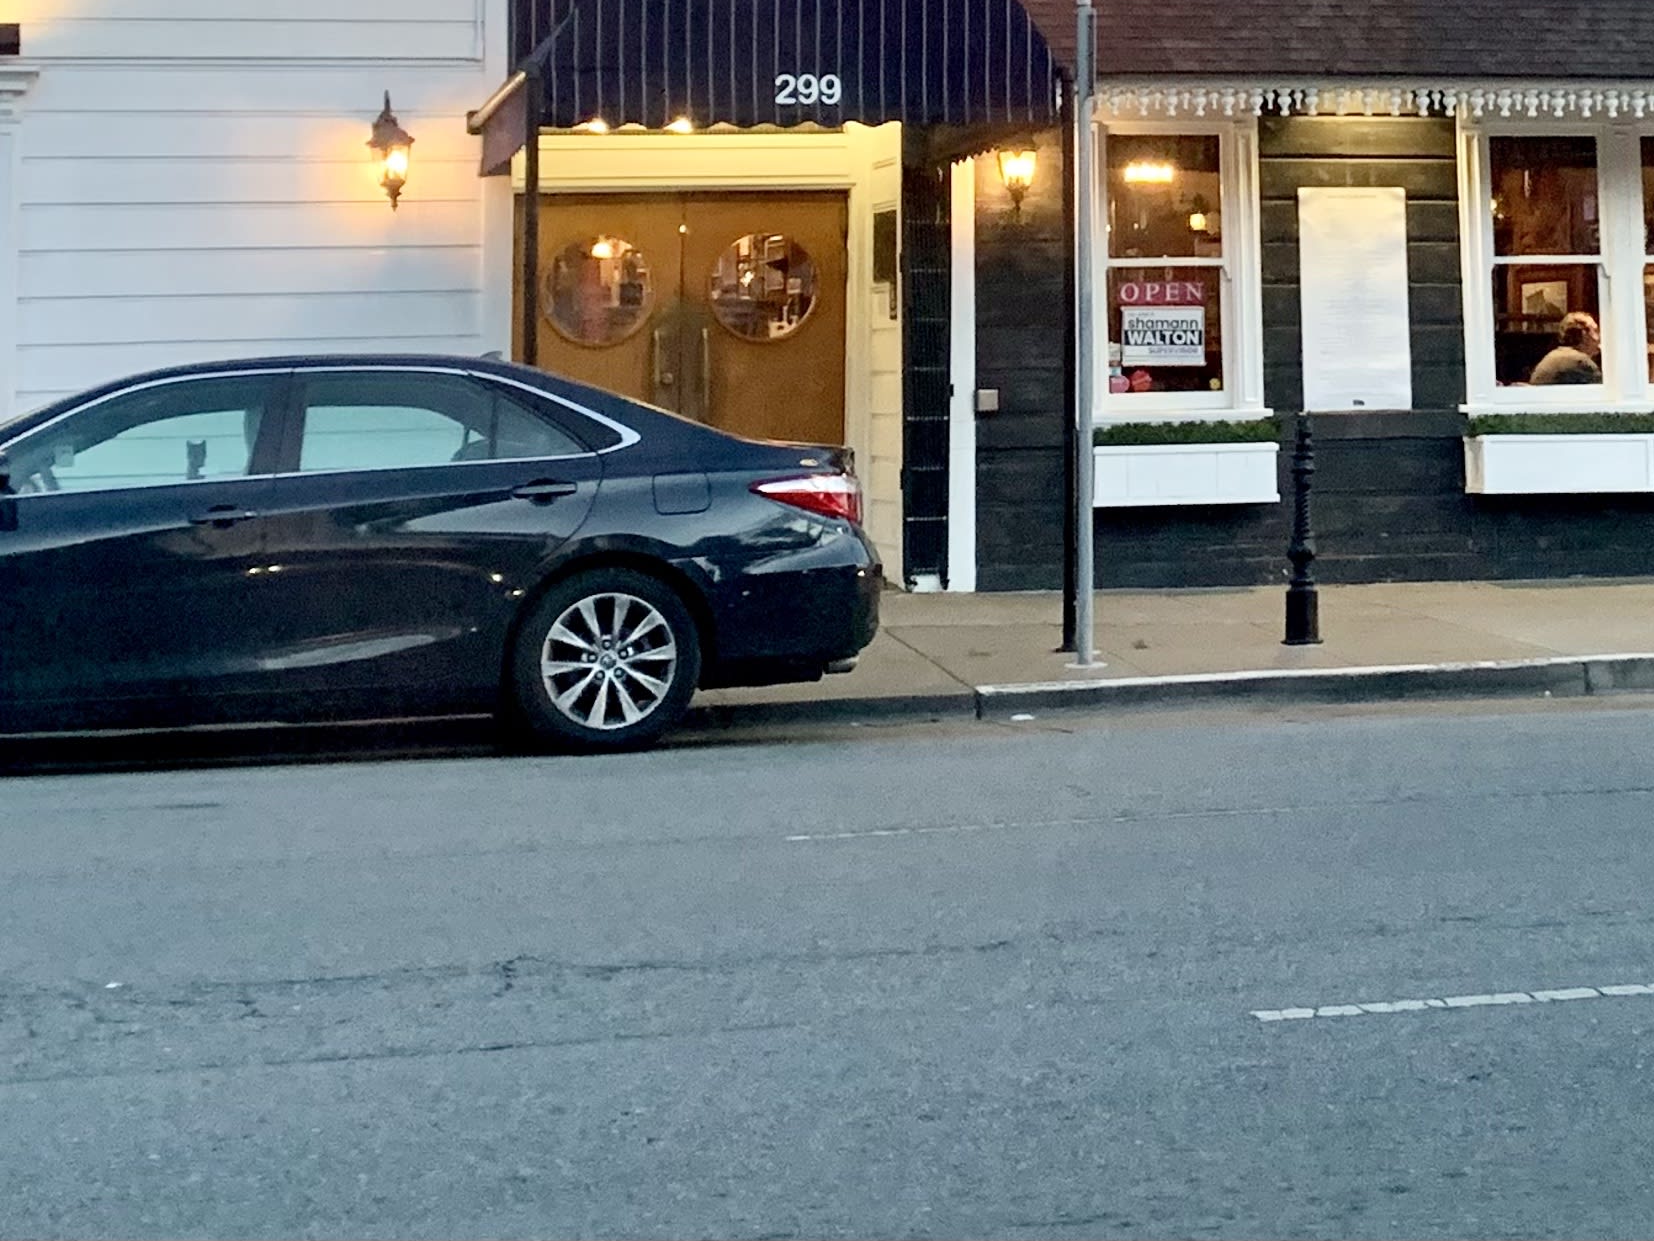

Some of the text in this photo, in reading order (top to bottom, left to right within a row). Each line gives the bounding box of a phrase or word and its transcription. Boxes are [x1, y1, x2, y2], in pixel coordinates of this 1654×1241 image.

[774, 73, 842, 105] 299
[1120, 282, 1204, 302] OPEN
[1128, 317, 1199, 330] shamann
[1127, 330, 1200, 346] WALTON
